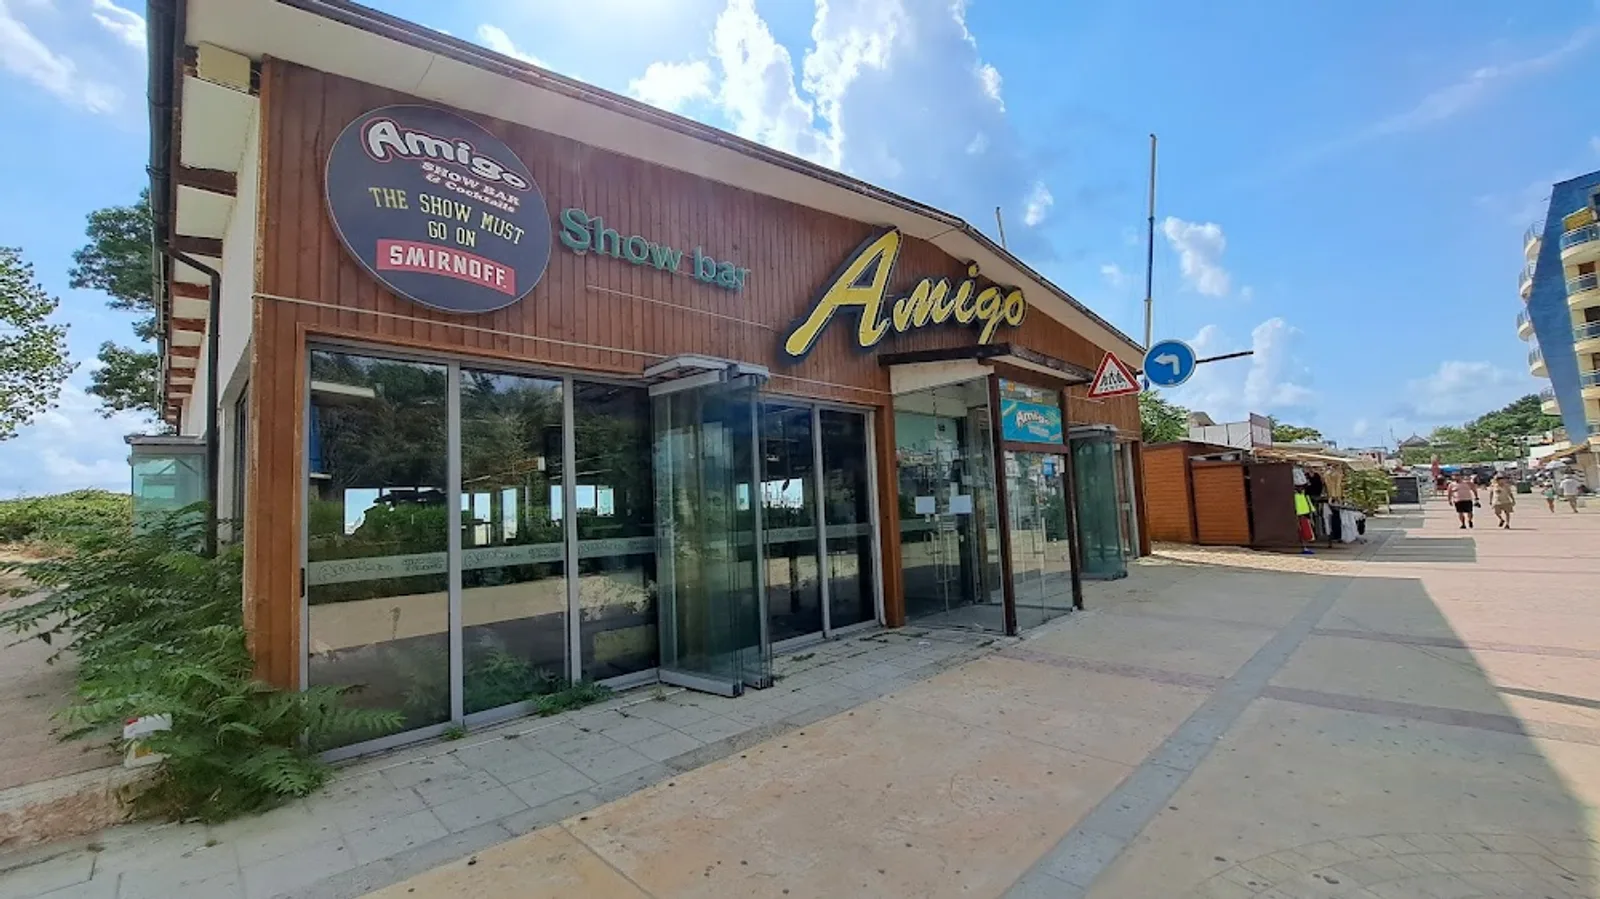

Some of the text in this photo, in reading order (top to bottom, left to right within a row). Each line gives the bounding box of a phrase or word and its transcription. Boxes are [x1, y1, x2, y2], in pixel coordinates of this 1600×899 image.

[367, 120, 527, 189] Amigo
[422, 161, 520, 206] SHOW BAR
[368, 187, 525, 246] THE SHOW MUST
[444, 180, 516, 213] Cocktails
[428, 220, 476, 248] GO ON
[559, 207, 750, 294] Show bar
[785, 230, 1027, 356] Amigo
